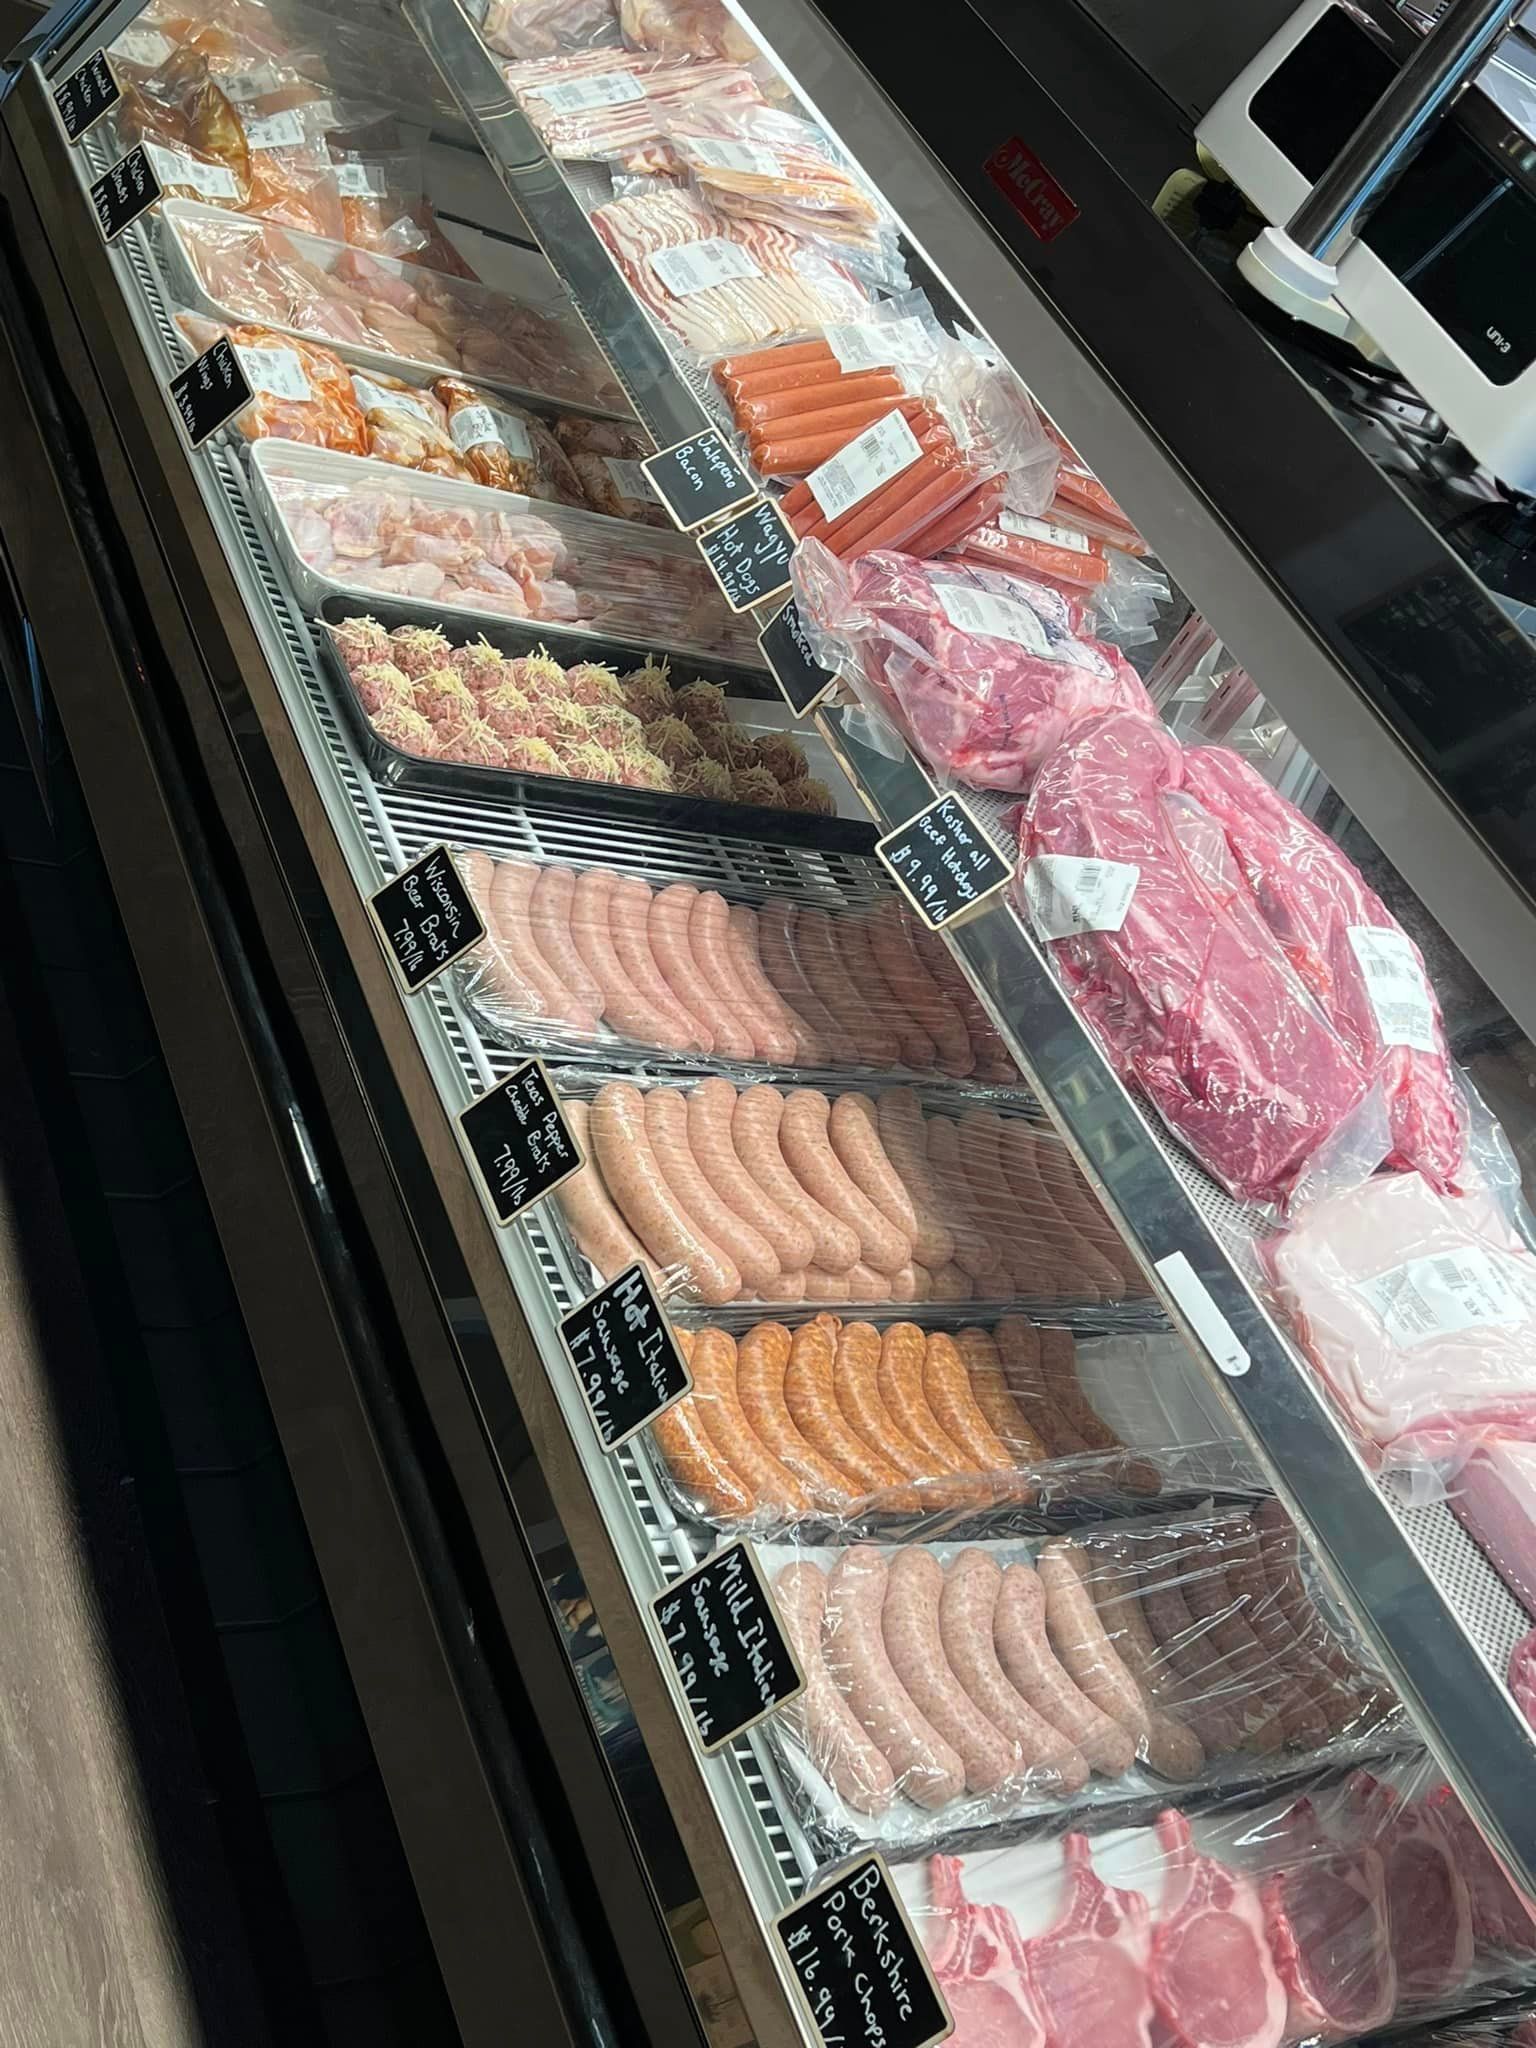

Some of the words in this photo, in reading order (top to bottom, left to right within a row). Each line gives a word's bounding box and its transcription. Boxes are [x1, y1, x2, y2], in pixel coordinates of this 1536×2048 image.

[75, 68, 91, 107] Chicken
[127, 150, 145, 196] Chicken
[1007, 151, 1064, 230] McCray
[197, 355, 213, 390] Wings
[213, 341, 232, 389] Chicken
[675, 445, 704, 491] Bacon
[716, 523, 744, 557] Hot
[735, 557, 760, 595] Dogs
[754, 503, 790, 565] Wagyu
[782, 605, 815, 667] Smoked
[919, 815, 947, 846] Beef
[936, 799, 973, 845] Kosher
[969, 850, 991, 871] all
[403, 874, 424, 909] Beer
[419, 914, 449, 961] Brats
[424, 856, 462, 939] Wisconsin
[394, 918, 424, 972] 7.99/lb
[521, 1068, 545, 1107] Texas
[542, 1111, 569, 1158] Pepper
[494, 1143, 529, 1206] 7.99/lb
[527, 1130, 551, 1174] Brats
[613, 1270, 650, 1332] Hot
[592, 1300, 630, 1395] Sausage
[691, 1576, 729, 1678] Sausage
[715, 1552, 754, 1626] Mild
[737, 1617, 777, 1711] Italian
[822, 1890, 856, 1968] Pork
[855, 1973, 887, 2048] Chops
[848, 1864, 913, 2021] Berkshire
[787, 1924, 845, 2048] $16.99/
